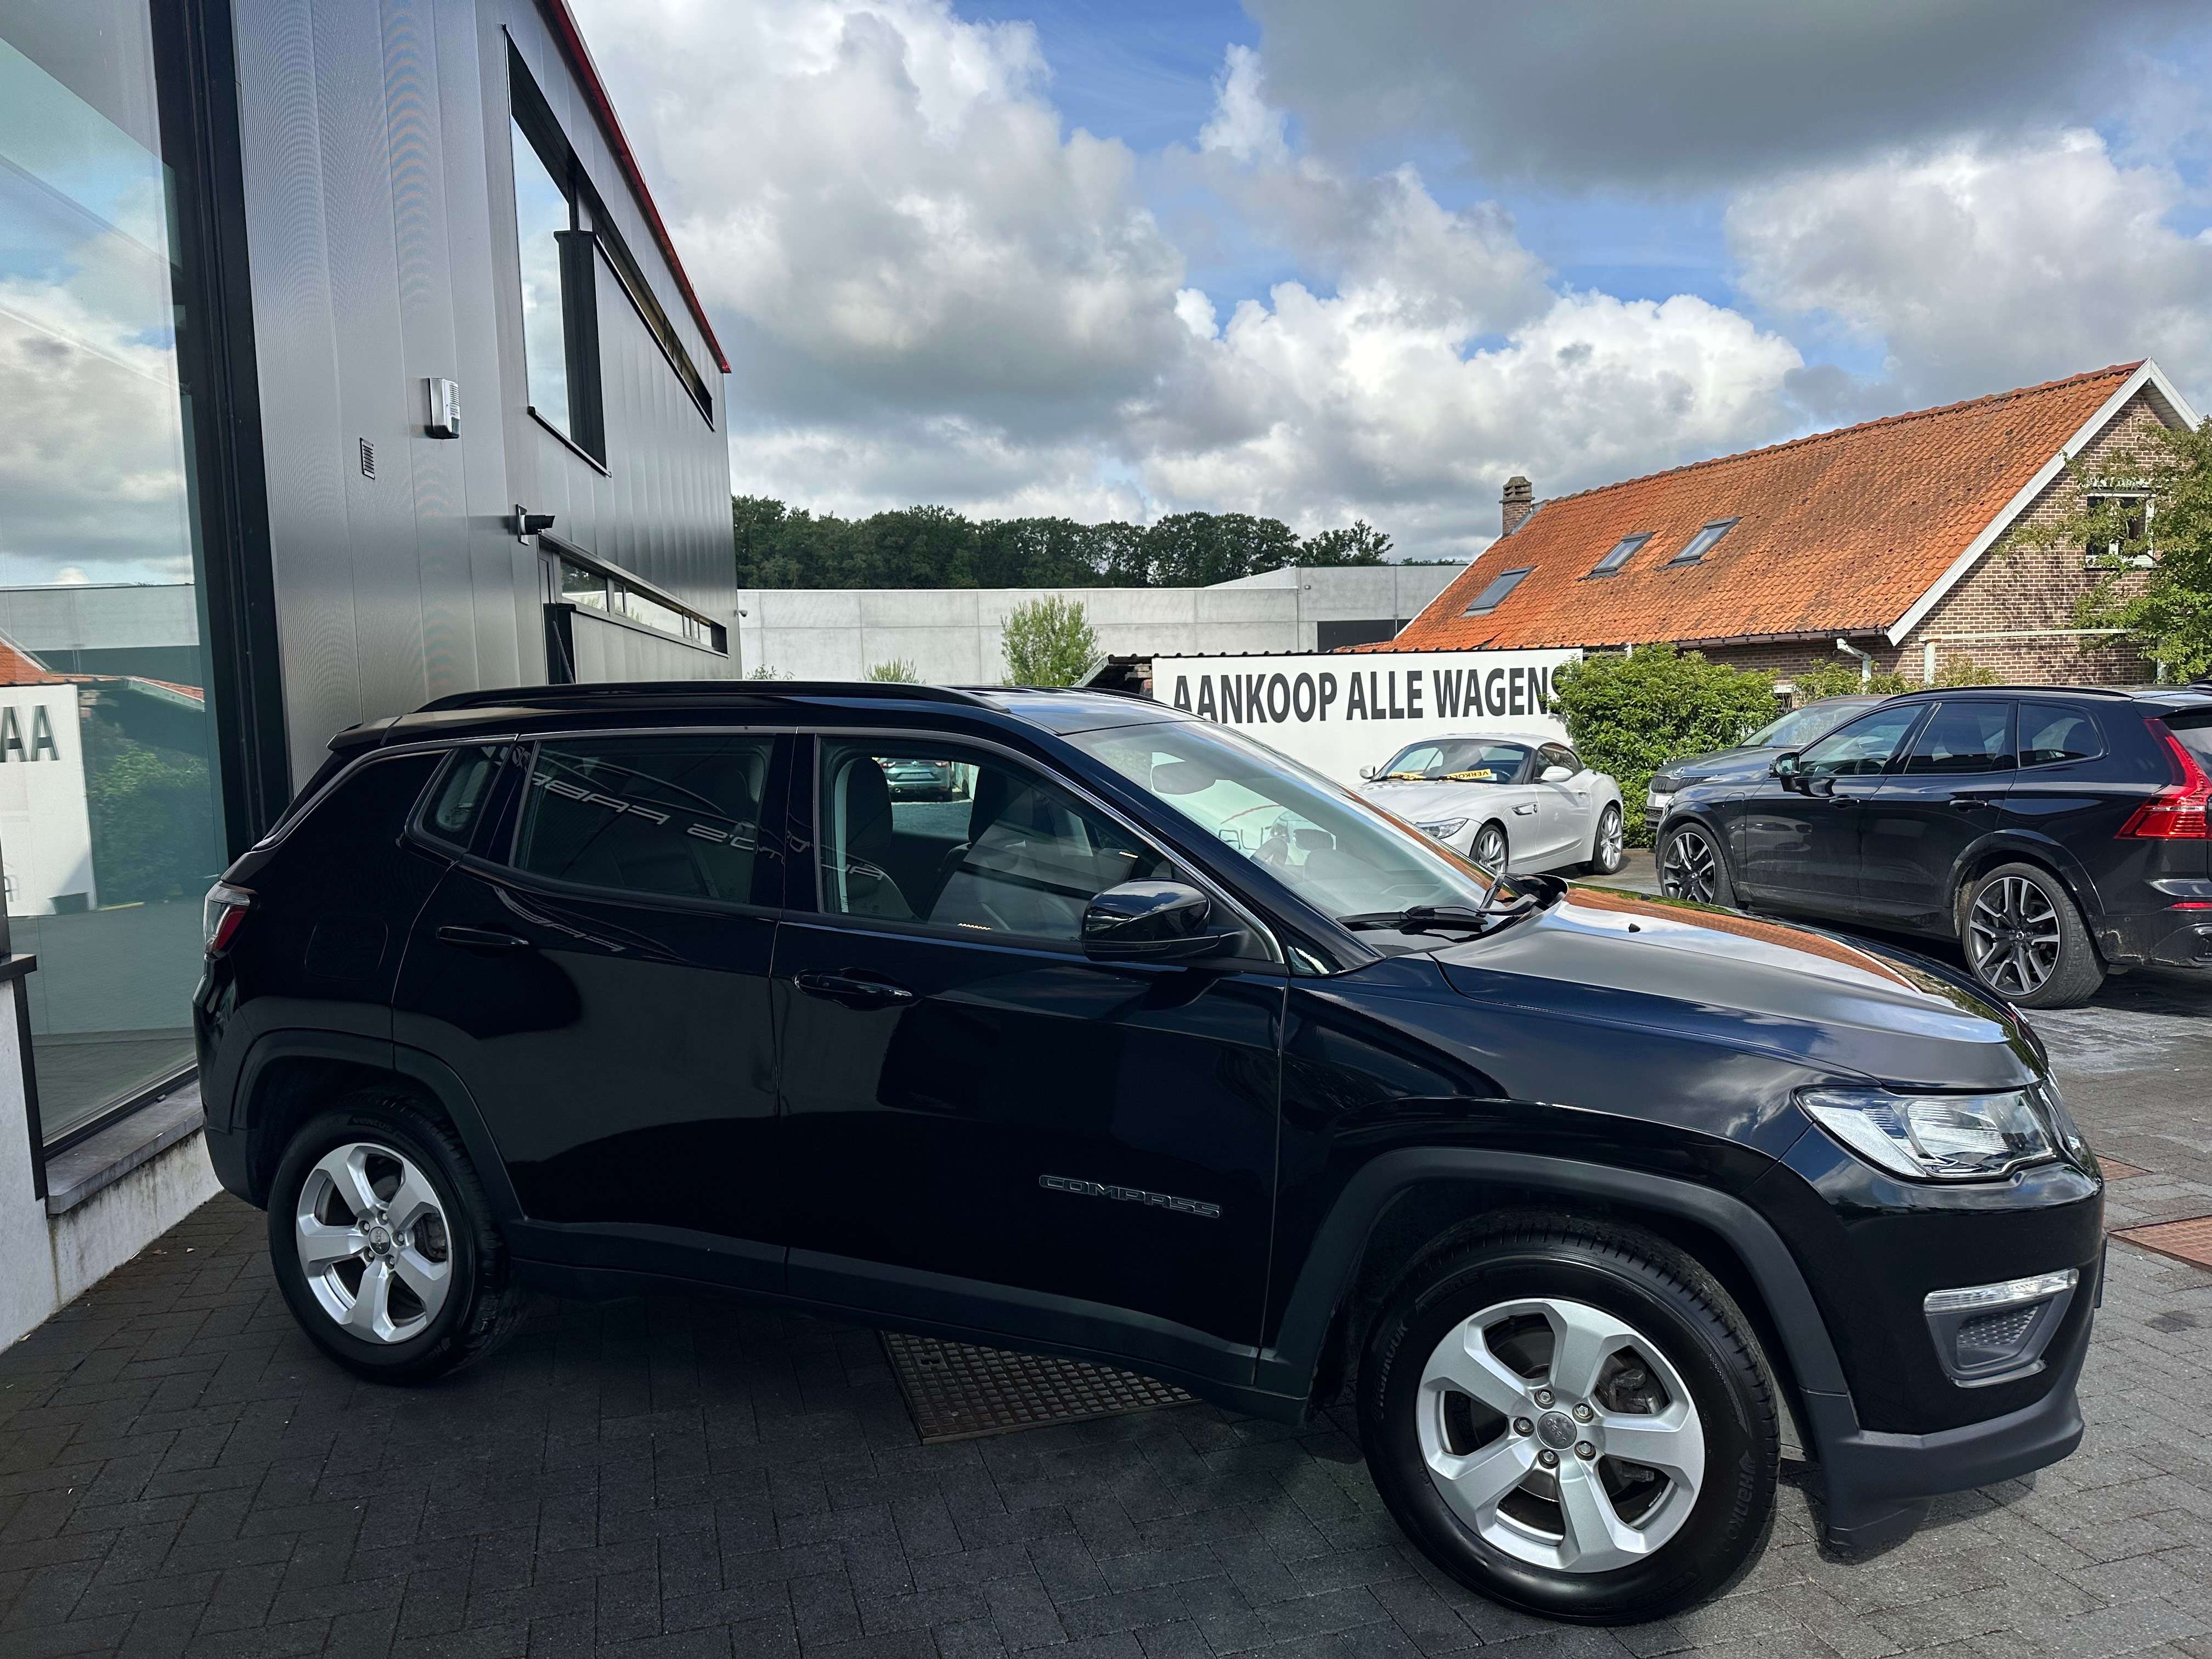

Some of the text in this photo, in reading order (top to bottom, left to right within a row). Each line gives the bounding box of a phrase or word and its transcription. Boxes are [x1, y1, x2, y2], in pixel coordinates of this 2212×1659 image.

[1173, 672, 1338, 724] AANKOOP
[1346, 670, 1424, 720] ALLE
[1039, 1175, 1220, 1218] COMPASS
